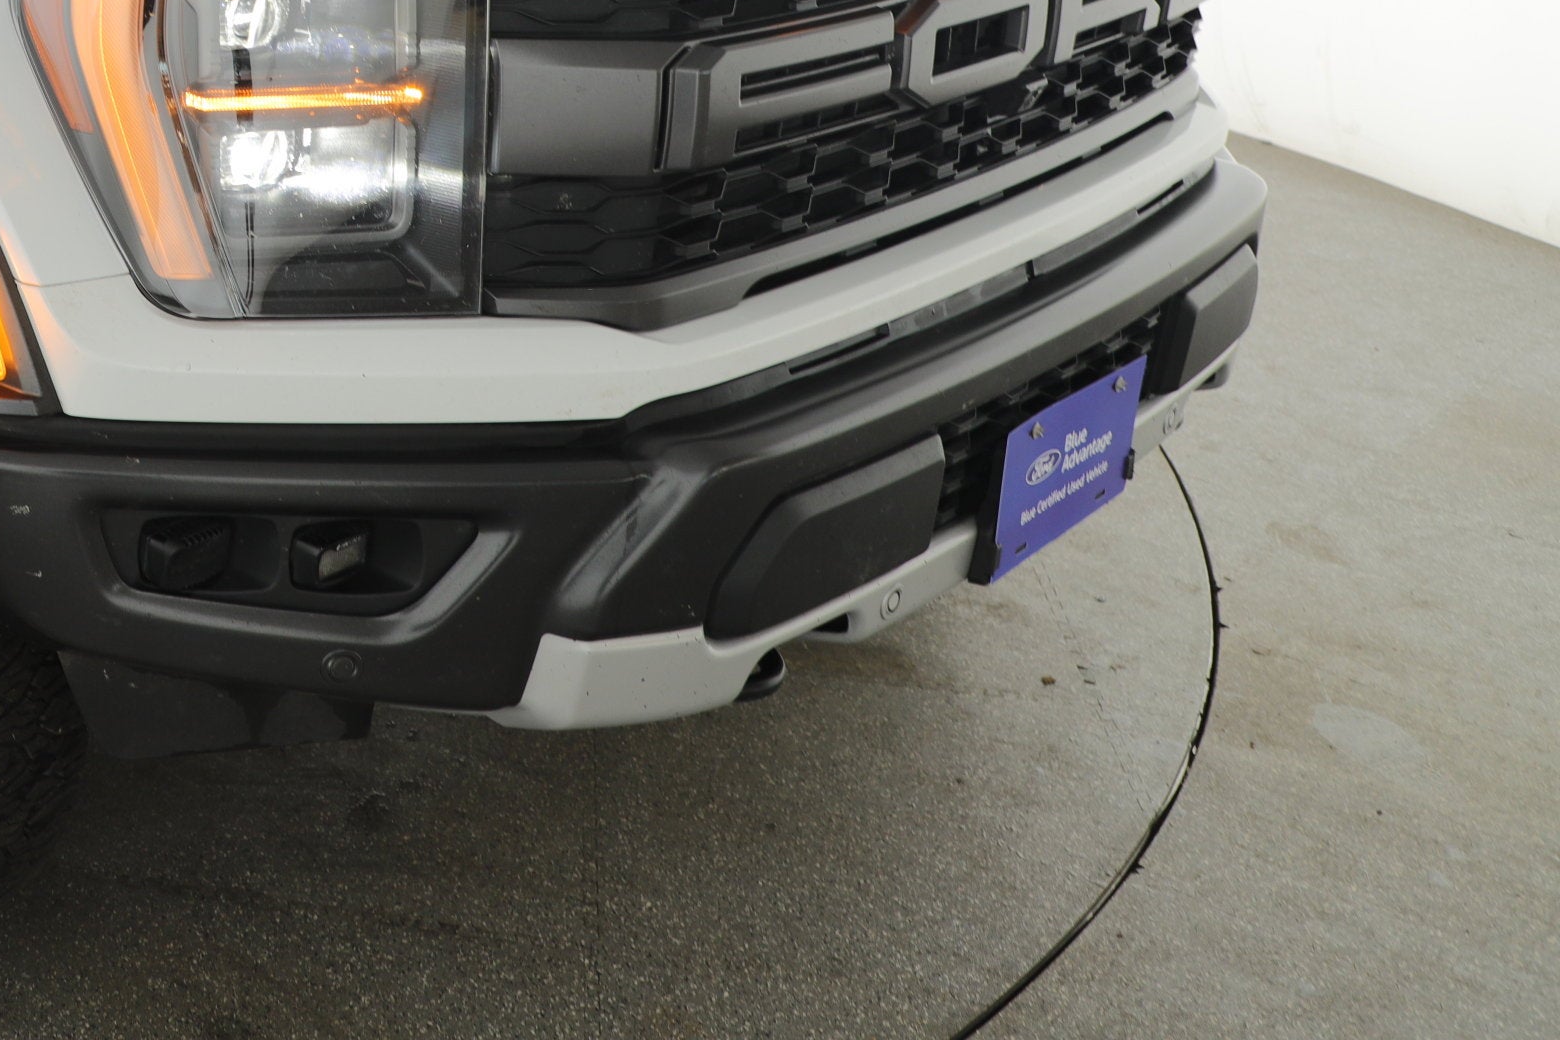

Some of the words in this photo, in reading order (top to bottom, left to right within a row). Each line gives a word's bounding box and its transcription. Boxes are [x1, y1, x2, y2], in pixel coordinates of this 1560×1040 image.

[1061, 430, 1112, 473] Advantage
[1064, 427, 1088, 452] Blue
[1020, 506, 1036, 526] Blue
[1037, 485, 1066, 514] Certified
[1066, 473, 1085, 495] Used
[1086, 460, 1108, 483] Vehicle
